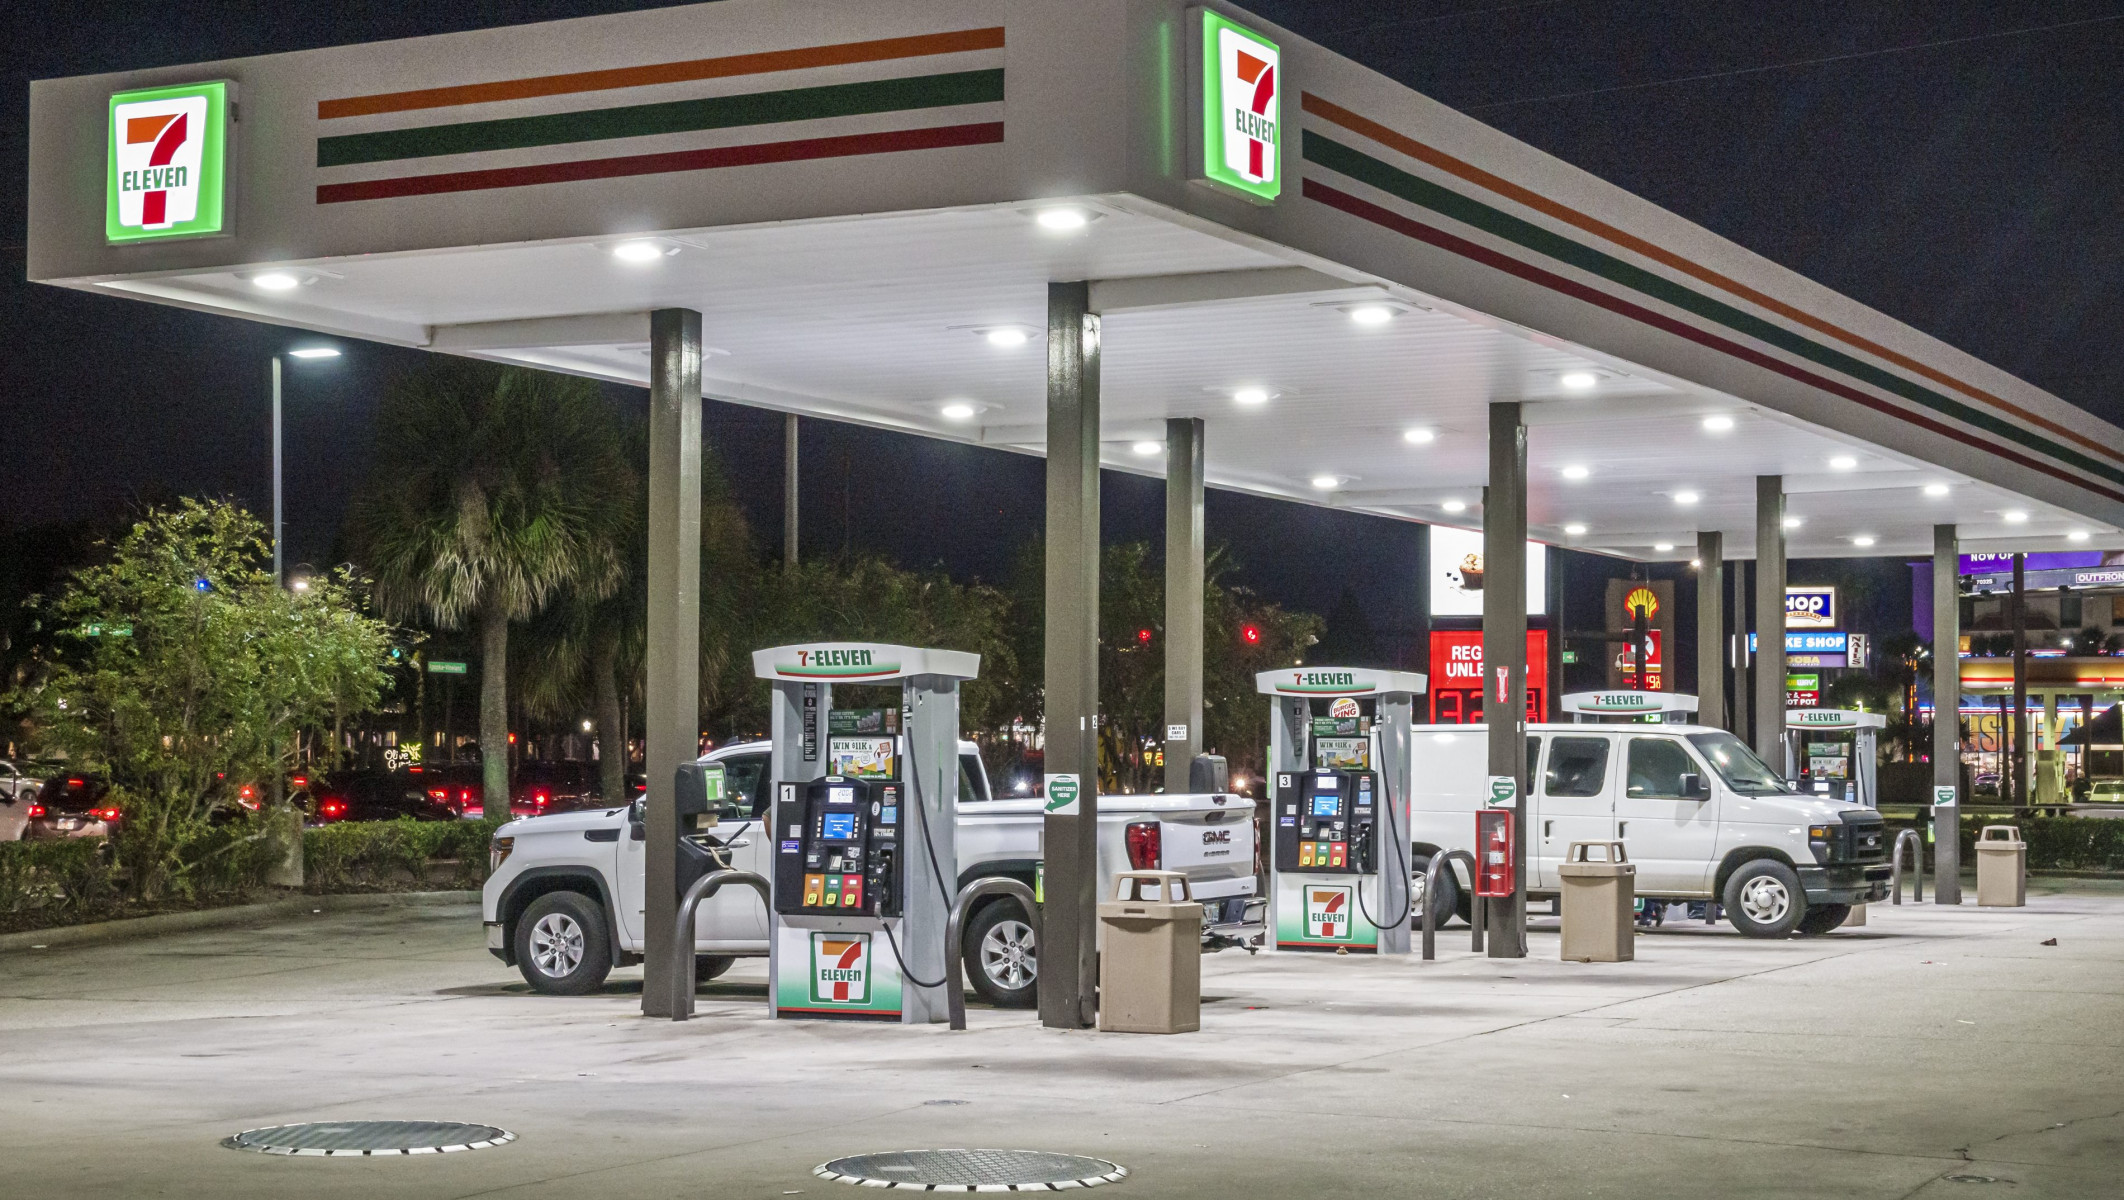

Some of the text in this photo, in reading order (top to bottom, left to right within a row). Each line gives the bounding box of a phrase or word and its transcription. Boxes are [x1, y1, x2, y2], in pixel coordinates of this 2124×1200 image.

[1970, 552, 2028, 562] NOW OPN
[2077, 572, 2124, 583] OUTFRON
[1785, 596, 1824, 613] HOP
[1805, 637, 1845, 648] SHOP
[1333, 702, 1356, 713] BURGER
[1799, 698, 1816, 706] POT
[1334, 708, 1357, 717] KING
[833, 741, 850, 750] WIN
[1282, 776, 1288, 786] 3
[784, 787, 791, 800] 1
[1202, 830, 1231, 843] GMC
